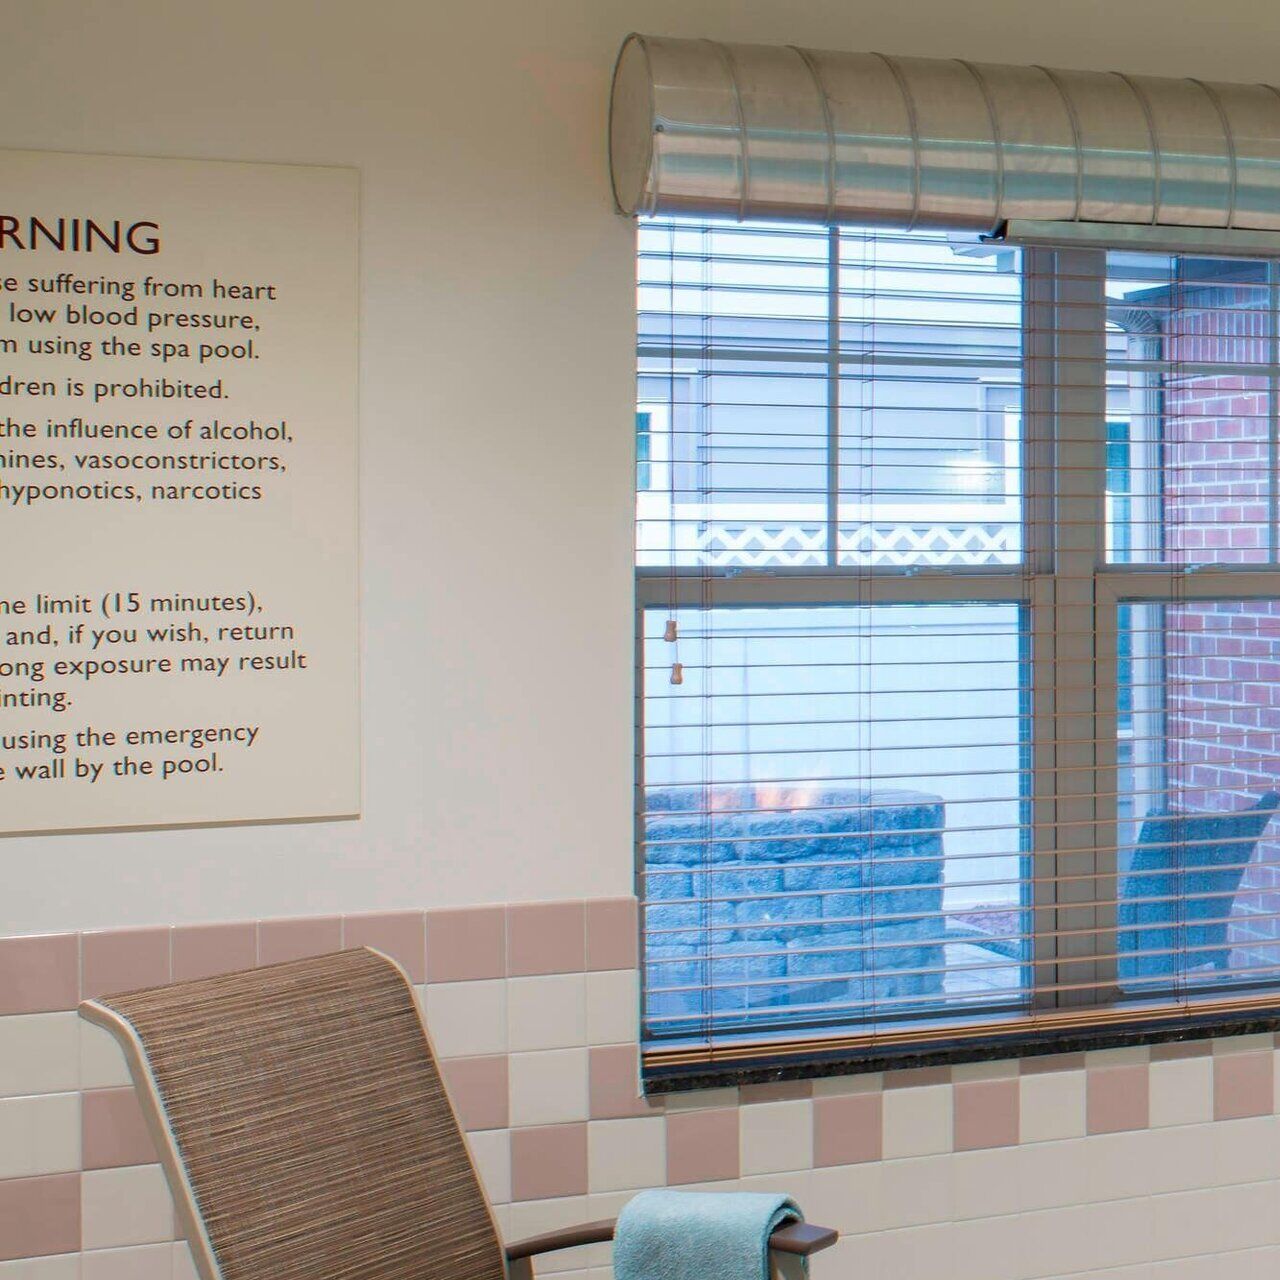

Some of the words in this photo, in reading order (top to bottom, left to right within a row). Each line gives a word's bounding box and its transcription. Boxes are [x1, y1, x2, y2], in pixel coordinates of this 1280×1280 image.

[0, 215, 160, 255] RNING
[28, 272, 136, 302] suffering
[143, 276, 203, 298] from
[213, 278, 277, 301] heart
[10, 302, 57, 324] low
[66, 303, 138, 326] blood
[148, 312, 260, 333] pressure,
[28, 335, 93, 362] using
[100, 335, 141, 357] the
[151, 342, 191, 363] spa
[199, 339, 260, 364] pool.
[67, 377, 84, 397] is
[94, 377, 229, 403] prohibited.
[46, 417, 158, 439] influence
[167, 419, 193, 440] of
[199, 419, 293, 443] alcohol,
[74, 451, 286, 473] vasoconstrictors,
[151, 481, 262, 500] narcotics
[36, 593, 92, 614] limit
[101, 592, 140, 619] (15
[150, 590, 263, 616] minutes),
[6, 624, 59, 647] and,
[68, 623, 85, 644] if
[91, 629, 137, 650] you
[146, 621, 209, 644] wish,
[218, 625, 294, 641] return
[53, 658, 172, 681] exposure
[181, 657, 230, 677] may
[239, 649, 308, 671] result
[2, 730, 67, 754] using
[75, 726, 116, 747] the
[125, 727, 259, 749] emergency
[14, 758, 65, 780] wall
[75, 757, 104, 784] by
[112, 755, 153, 776] the
[162, 752, 224, 780] pool.
